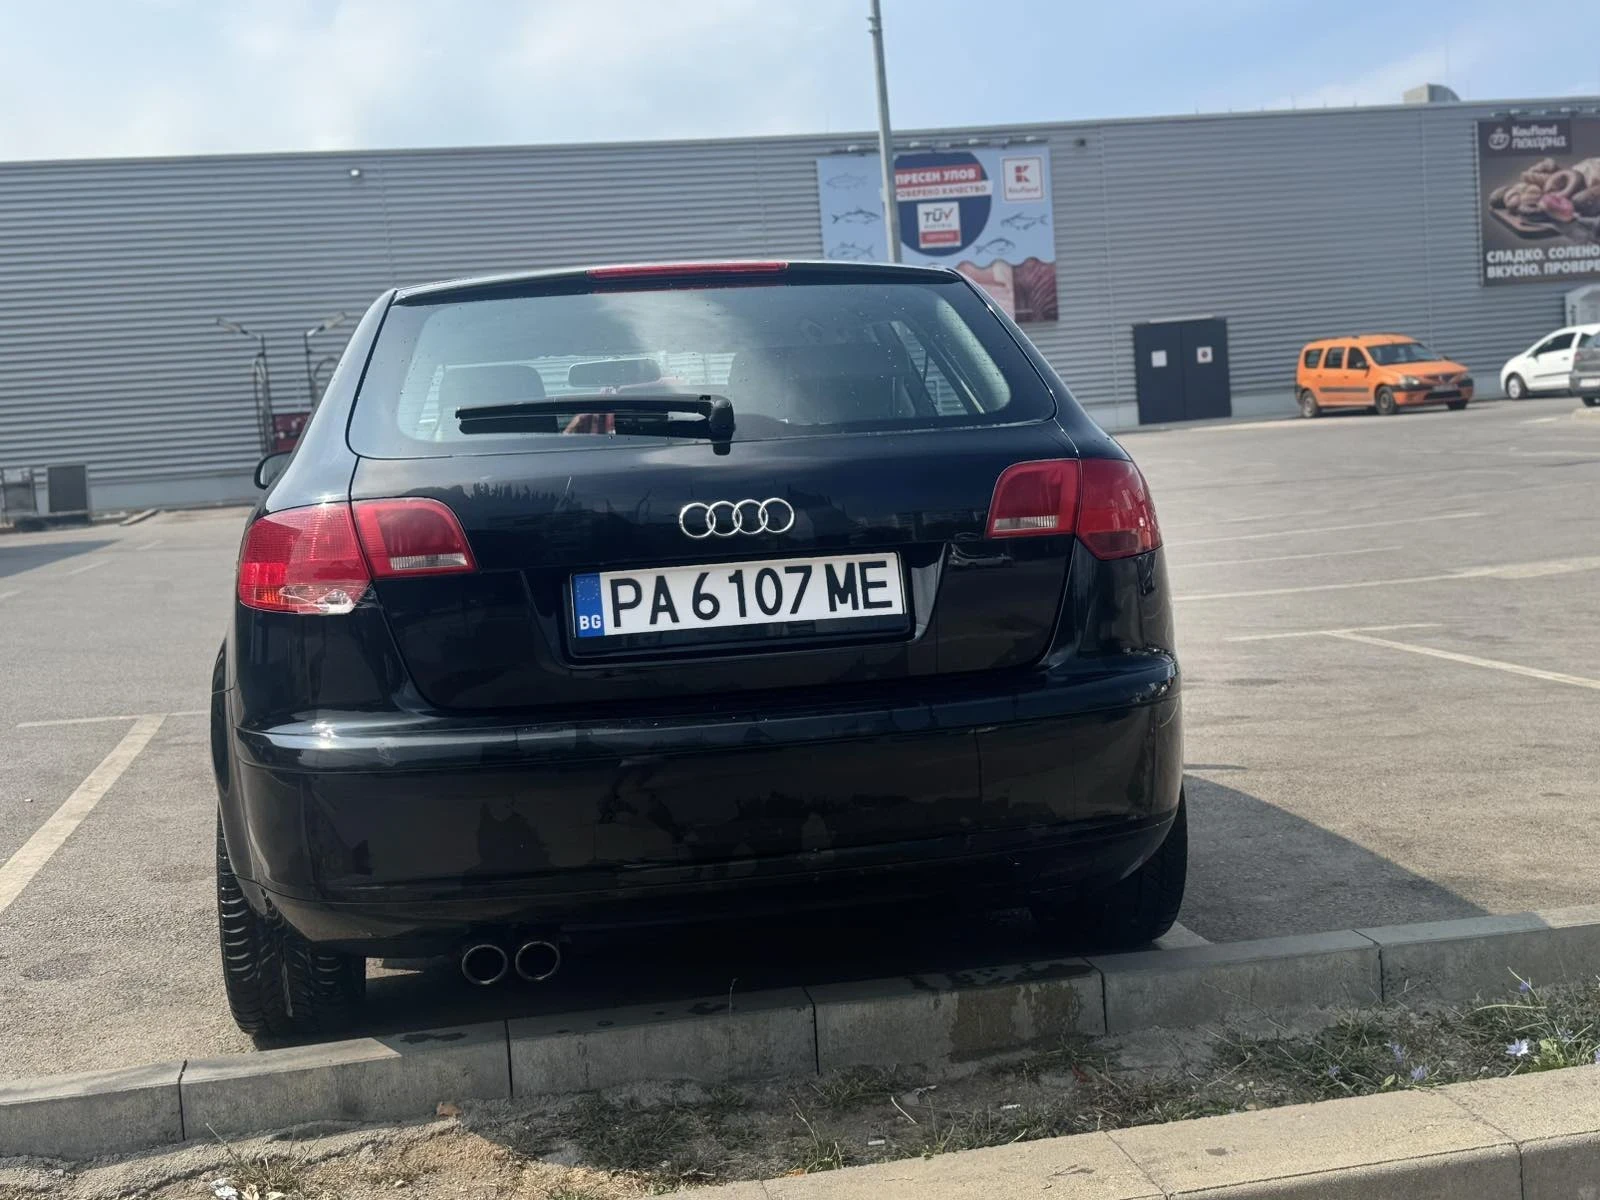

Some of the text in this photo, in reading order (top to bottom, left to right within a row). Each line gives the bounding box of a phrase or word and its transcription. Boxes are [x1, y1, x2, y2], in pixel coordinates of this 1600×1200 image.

[895, 168, 976, 185] ПРЕСЕН УЛОВ
[1486, 248, 1545, 263] СЛАДКО.
[1486, 263, 1541, 279] ВКУСНО.
[610, 560, 893, 628] PA 6107 ME
[579, 614, 602, 630] BG
